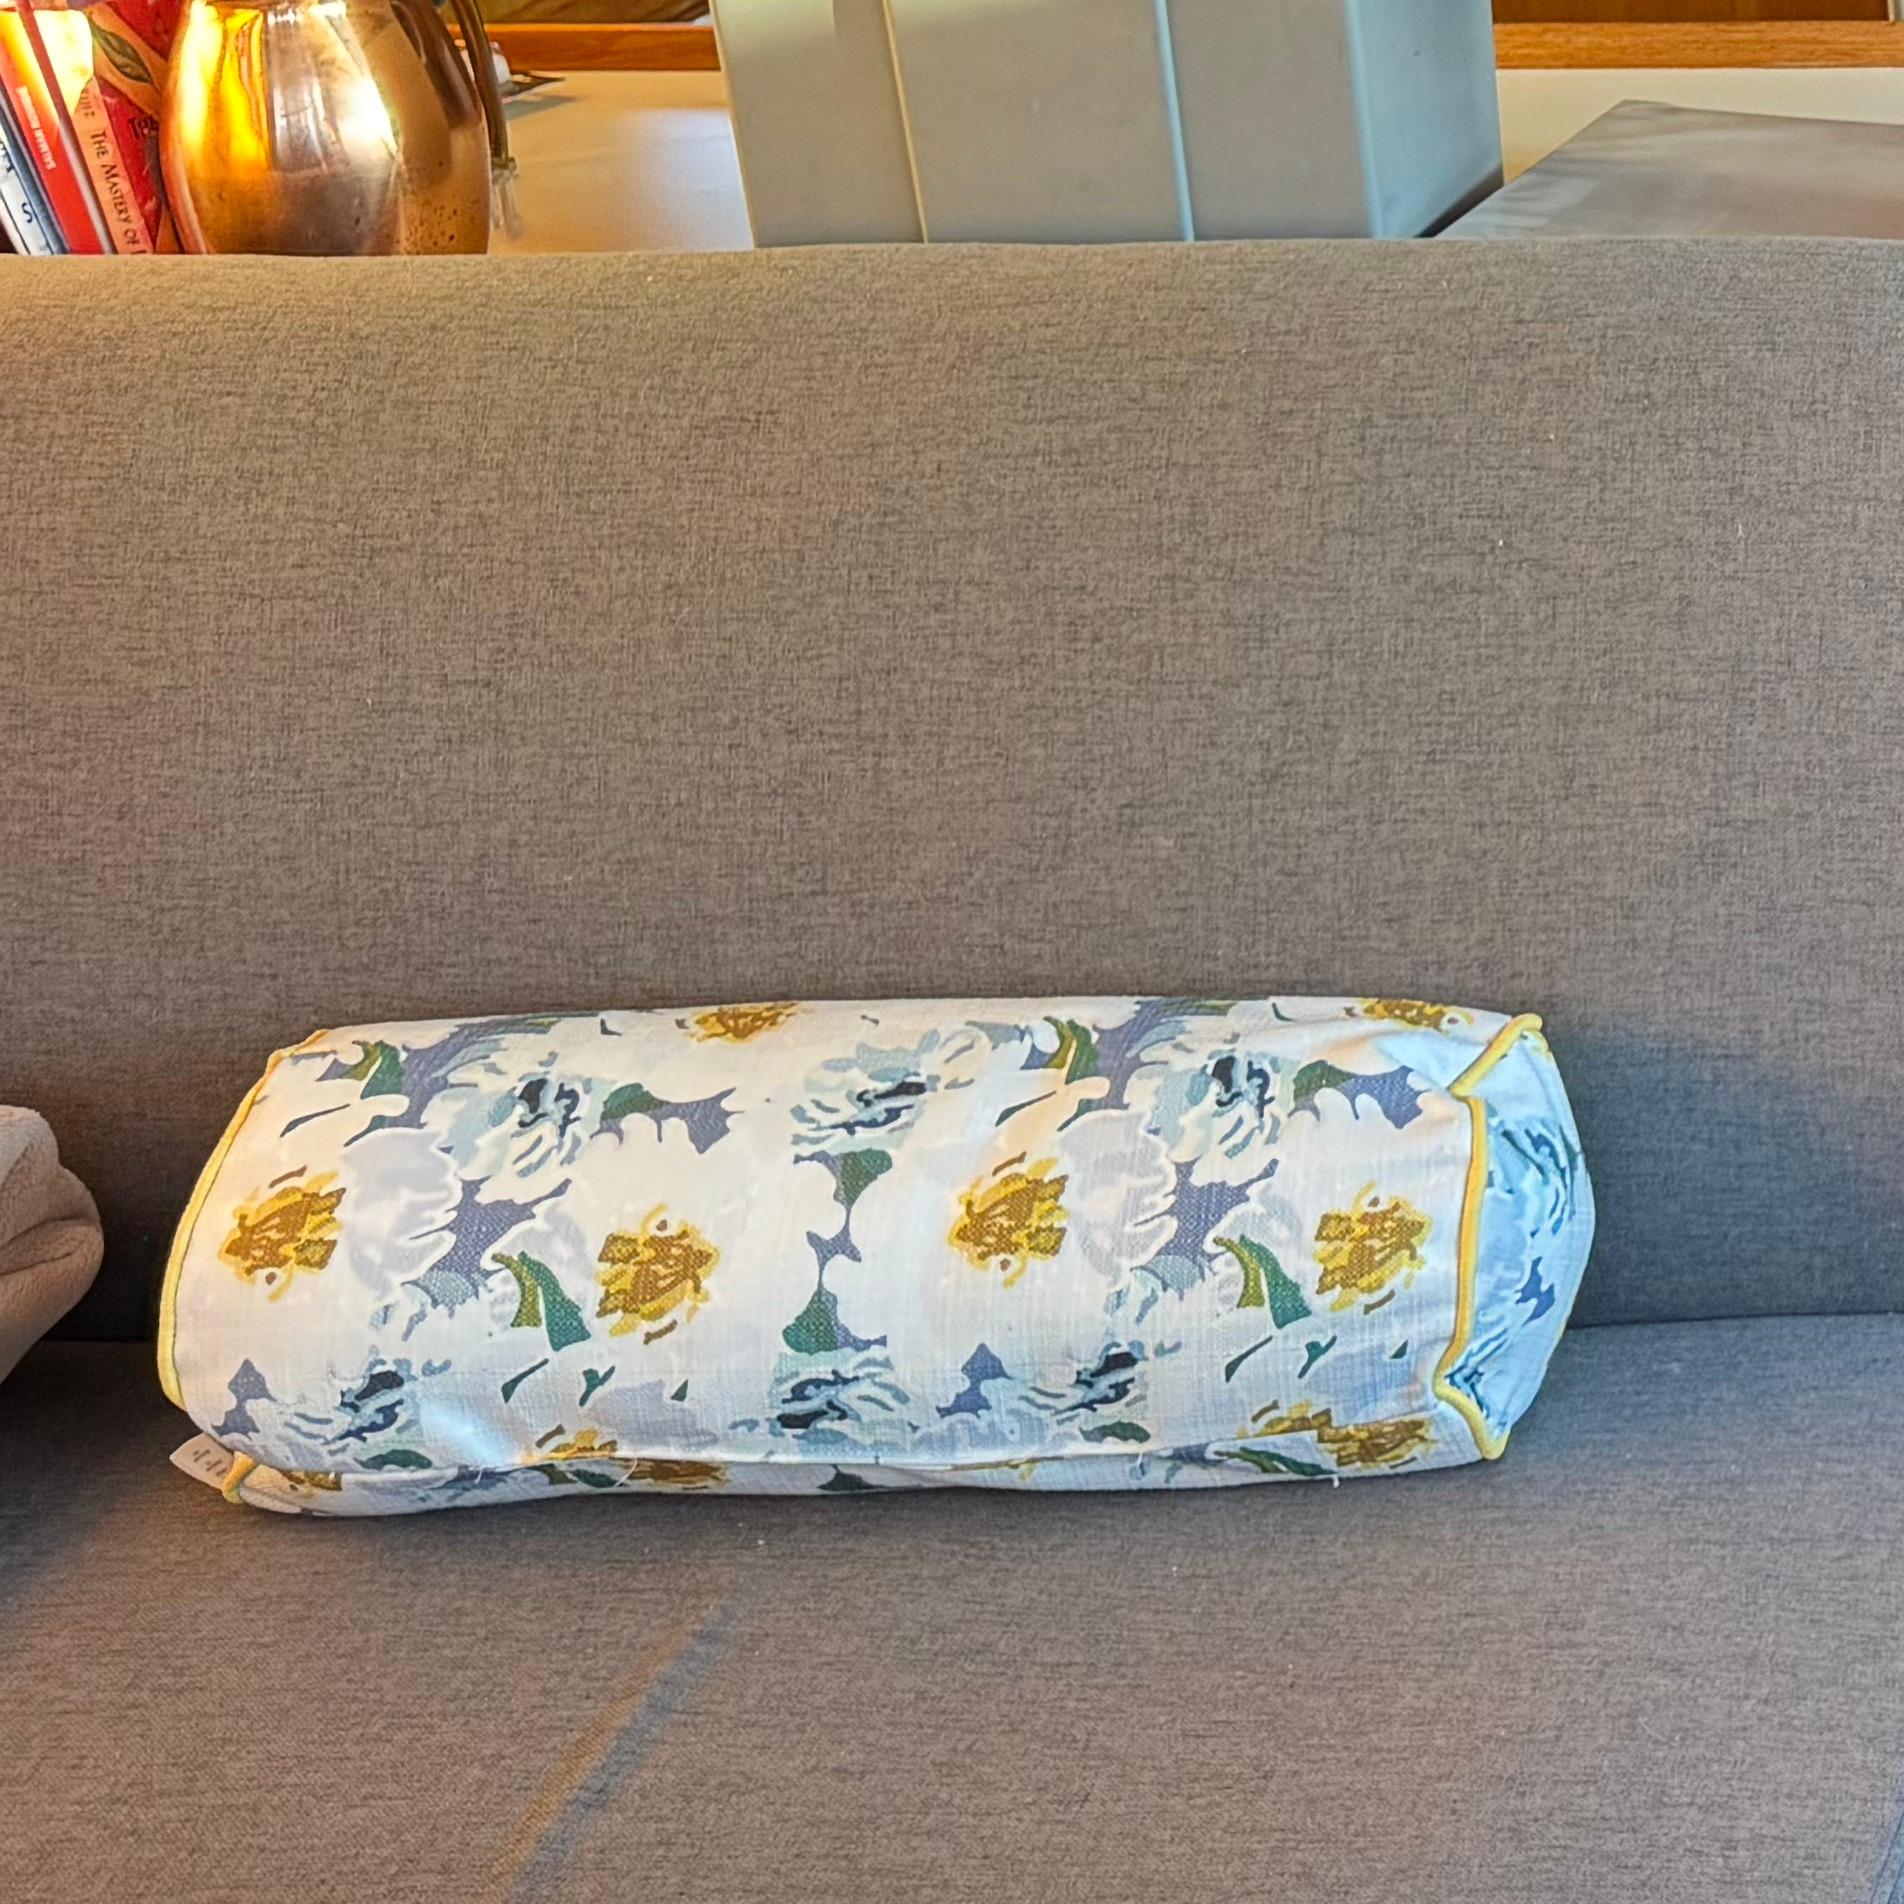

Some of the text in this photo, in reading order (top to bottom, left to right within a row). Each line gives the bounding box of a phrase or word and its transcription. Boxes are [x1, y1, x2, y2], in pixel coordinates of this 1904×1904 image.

[91, 130, 109, 159] THE
[101, 161, 131, 224] MASTERY
[123, 224, 141, 246] OF
